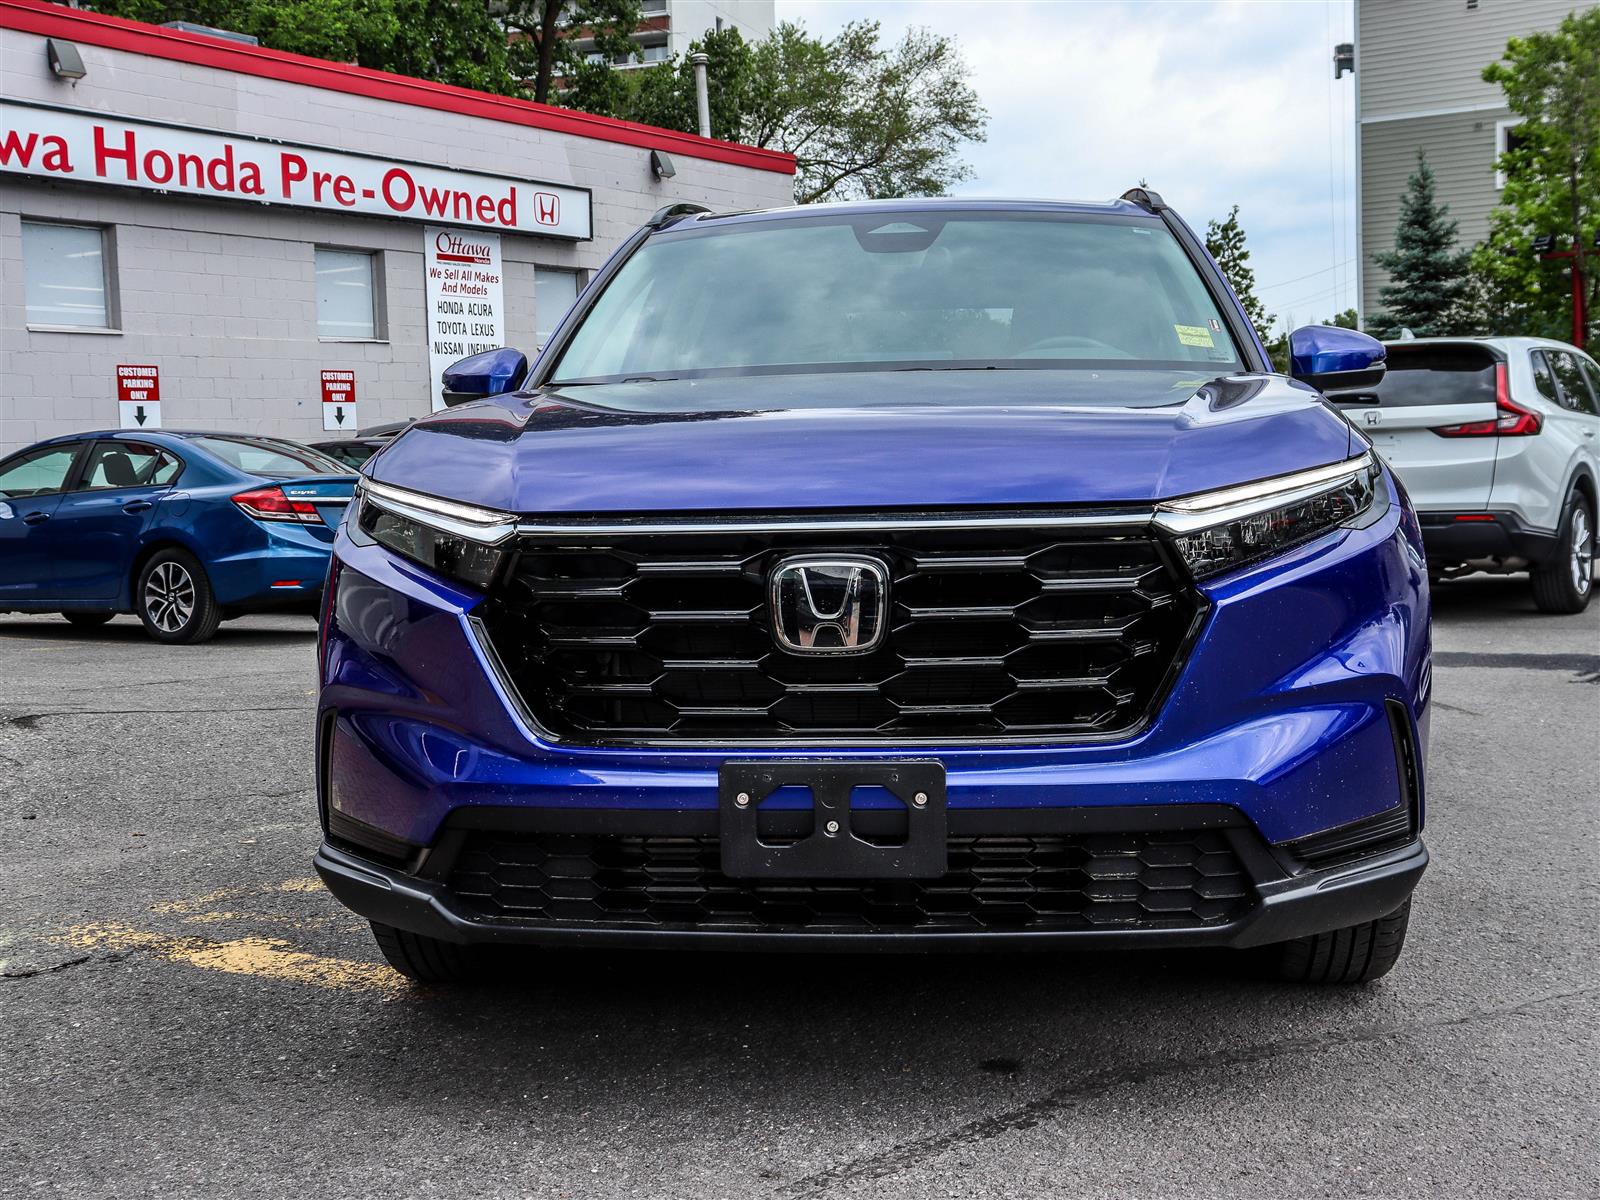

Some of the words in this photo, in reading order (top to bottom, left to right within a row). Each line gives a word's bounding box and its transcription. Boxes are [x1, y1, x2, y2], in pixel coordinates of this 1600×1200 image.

[93, 125, 265, 196] Honda
[280, 152, 518, 227] Pre-Owned
[435, 231, 491, 257] Ottawa
[429, 267, 442, 279] We
[444, 268, 459, 280] Sell
[461, 270, 472, 281] All
[474, 271, 499, 283] Makes
[441, 281, 458, 293] And
[460, 282, 488, 296] Models
[437, 300, 464, 315] HONDA
[467, 303, 493, 317] ACURA
[437, 321, 467, 336] TOYOTA
[471, 323, 495, 337] LEXUS
[434, 341, 464, 356] NISSAN
[118, 366, 157, 377] CUSTOMER
[322, 371, 354, 381] CUSTOMER
[122, 378, 154, 389] PARKING
[325, 382, 351, 391] PARKING
[130, 390, 148, 400] ONLY
[331, 393, 346, 402] ONLY
